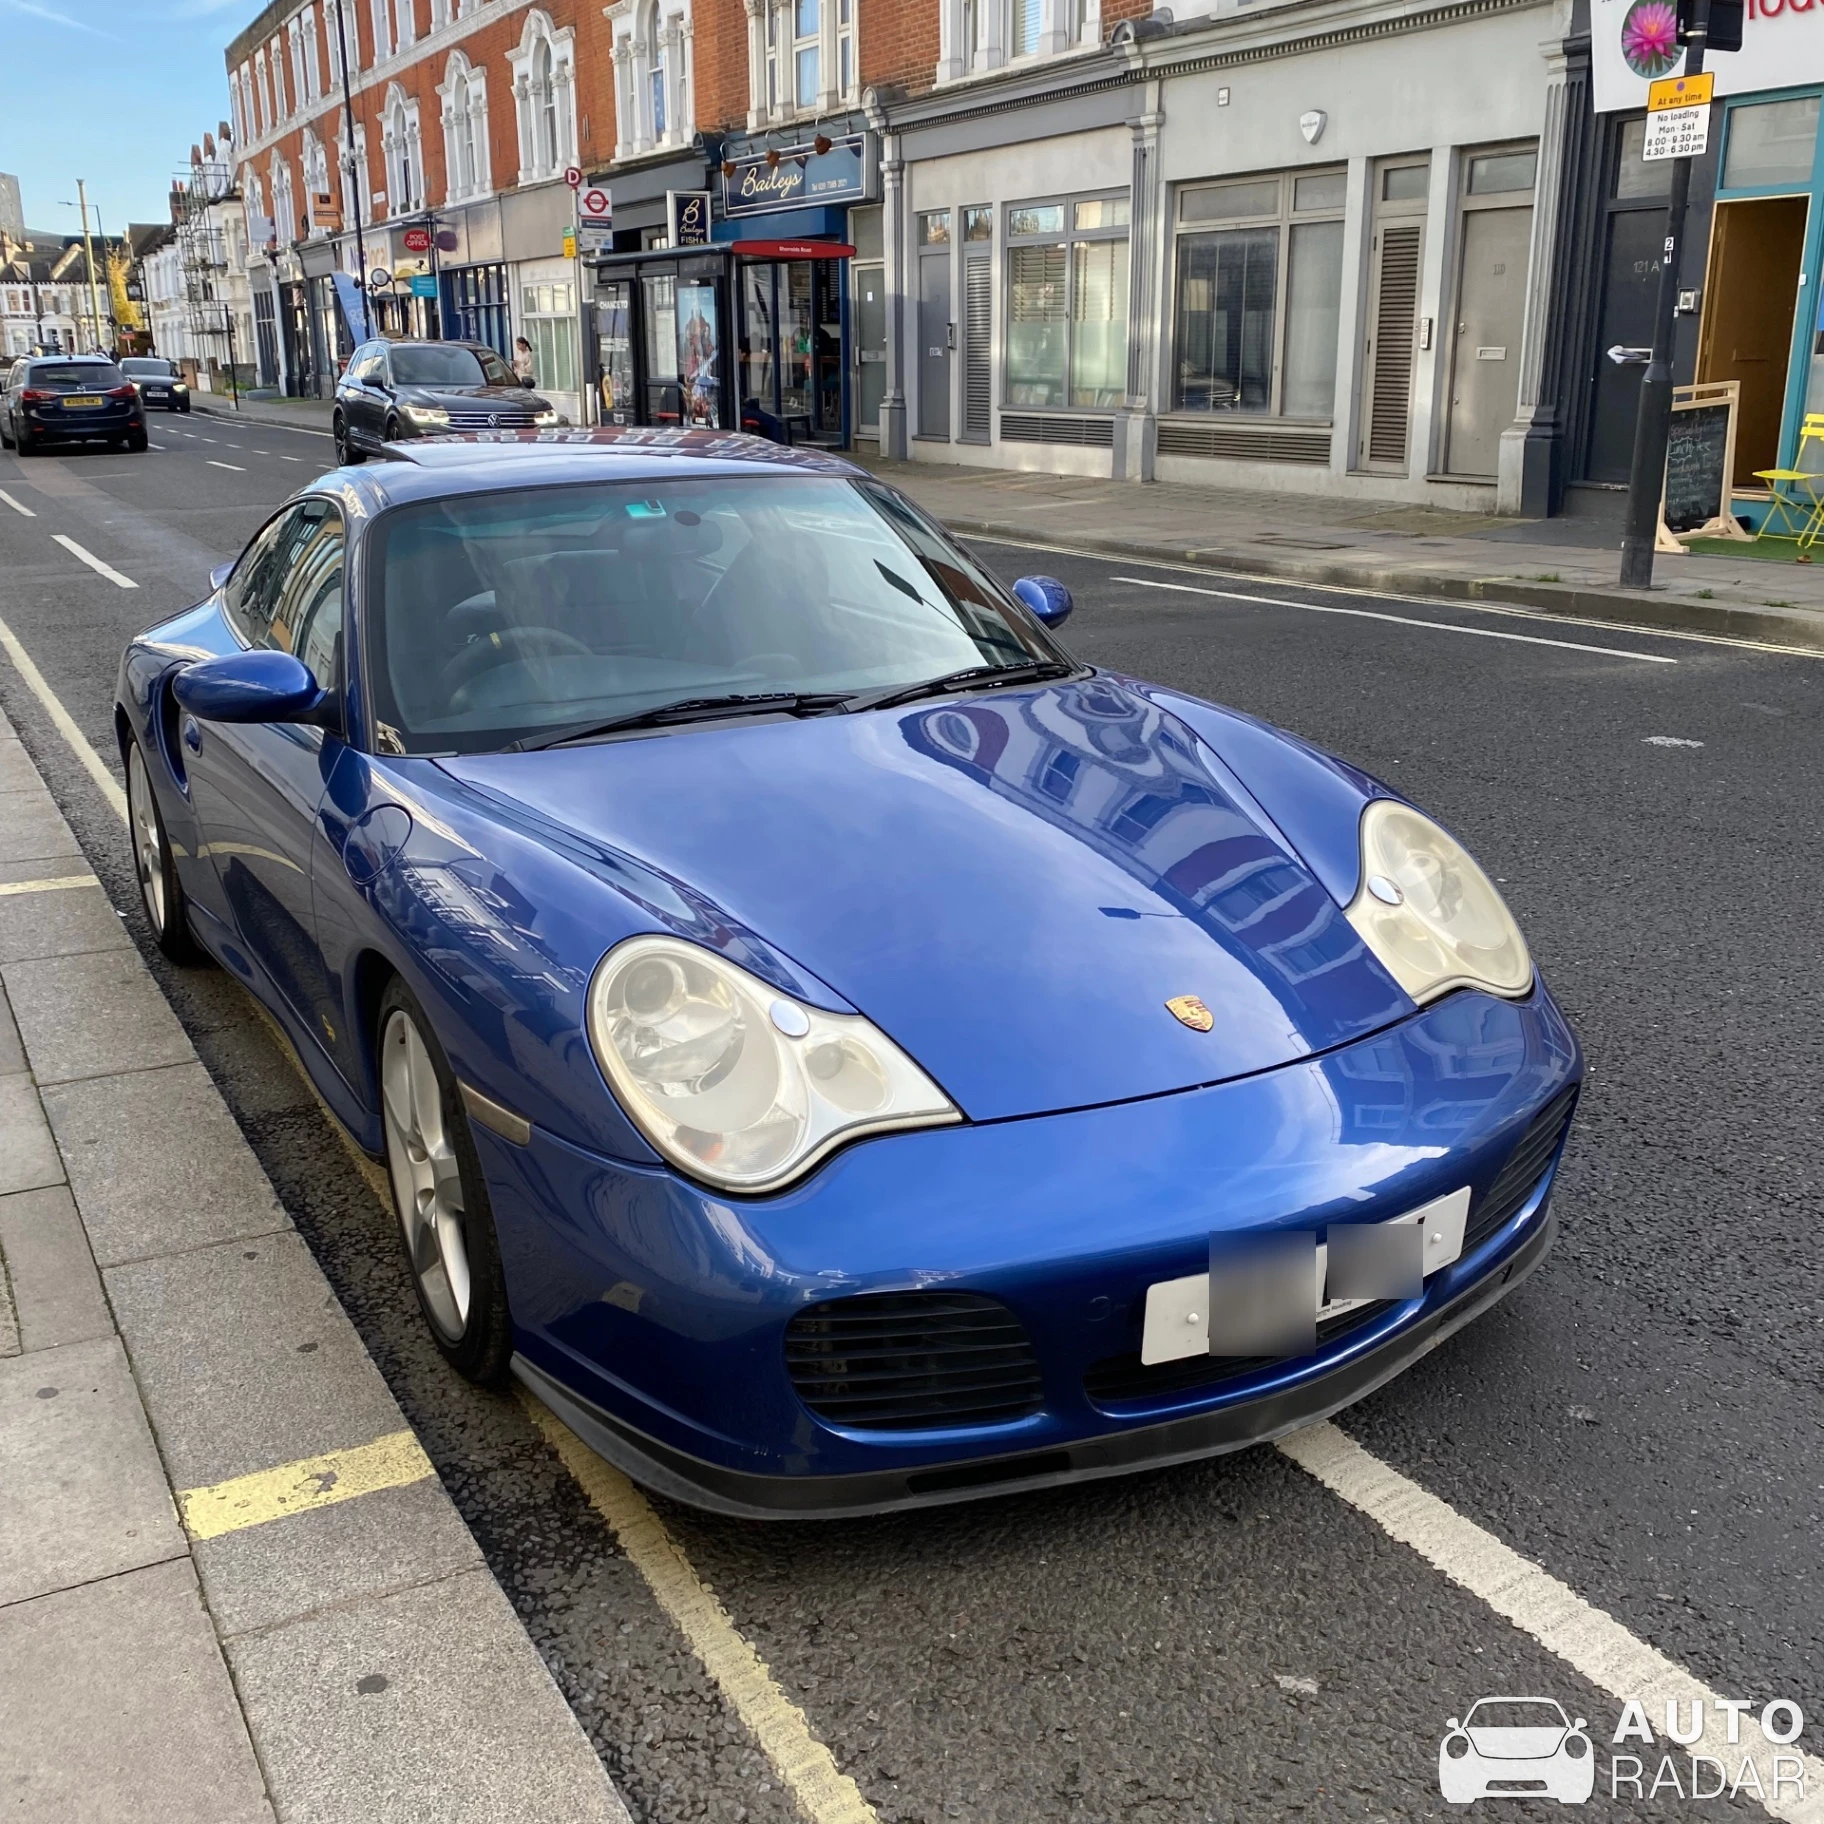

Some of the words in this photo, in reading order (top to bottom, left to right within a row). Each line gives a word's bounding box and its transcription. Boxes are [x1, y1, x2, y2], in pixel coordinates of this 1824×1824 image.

[1669, 96, 1682, 104] any
[1685, 93, 1702, 102] time
[1658, 114, 1668, 122] No
[1671, 110, 1699, 120] loading
[1659, 126, 1675, 134] Mon
[1681, 122, 1695, 131] Sat
[1647, 137, 1666, 147] 8.00
[1672, 134, 1691, 144] 9.30
[1646, 147, 1665, 156] 4.30
[1671, 143, 1690, 153] 6.30
[1691, 143, 1703, 152] pm
[568, 169, 580, 184] D
[741, 166, 803, 198] Baileys
[680, 223, 705, 236] Baileys
[681, 236, 699, 244] FISH
[1633, 260, 1649, 273] 121
[1651, 259, 1660, 272] A
